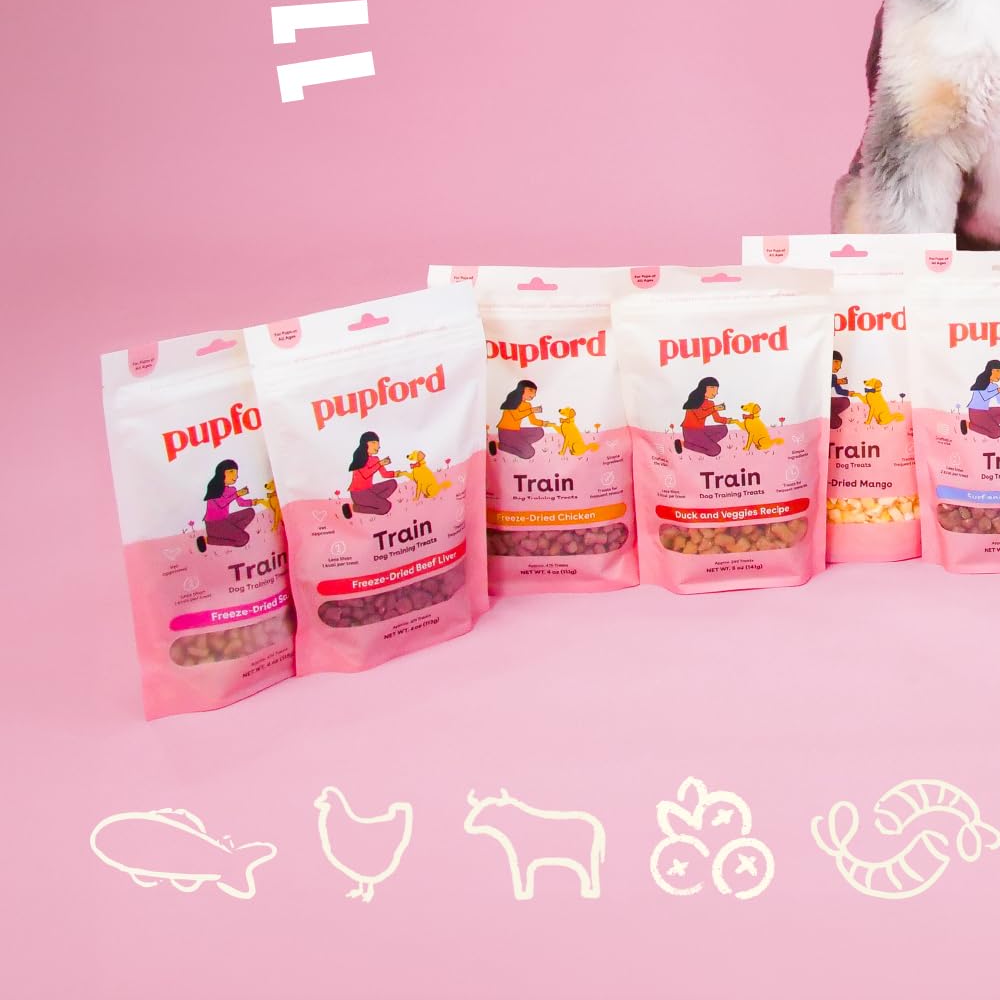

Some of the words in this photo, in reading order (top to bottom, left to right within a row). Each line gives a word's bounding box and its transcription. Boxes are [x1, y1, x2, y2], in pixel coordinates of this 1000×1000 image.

[658, 325, 788, 367] pupford
[311, 364, 445, 430] pupford
[828, 441, 880, 459] Train
[513, 473, 574, 492] Train
[700, 468, 761, 489] Train
[860, 480, 893, 490] Mango
[497, 514, 555, 522] Freeze-Dried
[558, 511, 596, 520] Chicken
[675, 510, 698, 519] Duck
[700, 511, 718, 519] and
[721, 508, 758, 520] Veggies
[760, 505, 790, 516] Recipe
[373, 520, 432, 550] Train
[390, 546, 416, 557] Training
[416, 538, 437, 547] Treats
[228, 551, 287, 582] Train
[352, 566, 414, 589] Freeze-Dried
[416, 558, 436, 572] Beef
[438, 552, 457, 564] Liver
[228, 586, 245, 594] Dog
[247, 577, 275, 590] Training
[211, 598, 278, 621] Freeze-Dried
[384, 632, 396, 640] NET
